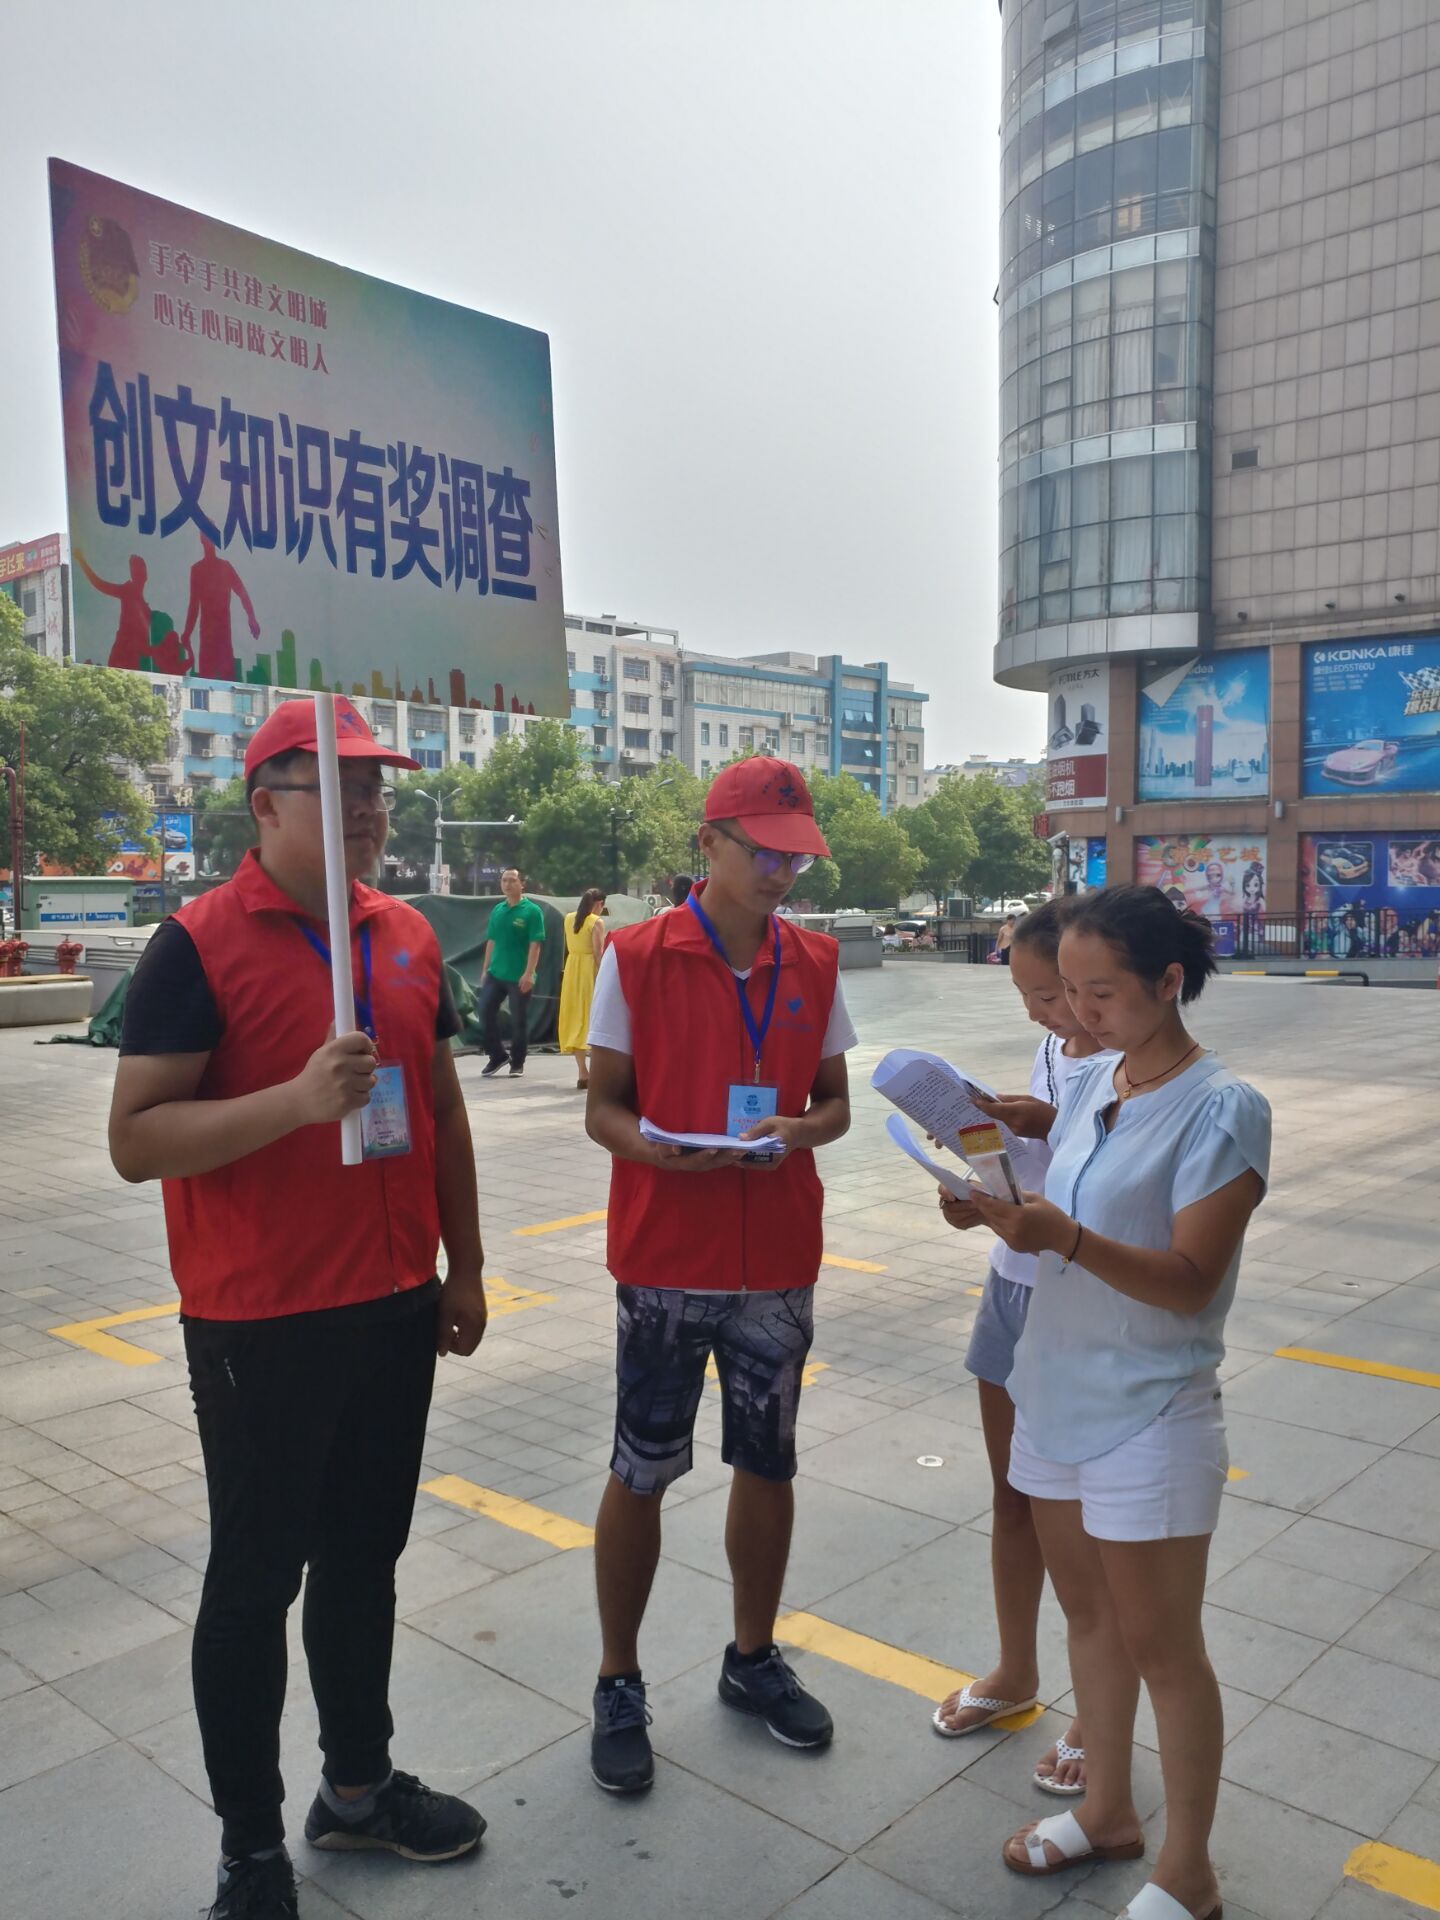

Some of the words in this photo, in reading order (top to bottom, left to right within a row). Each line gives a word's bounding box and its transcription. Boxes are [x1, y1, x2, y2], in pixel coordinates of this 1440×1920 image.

[149, 240, 328, 331] 手牵手共建文明城
[152, 291, 331, 374] 心连心同做文明人
[88, 360, 538, 601] 创文知识有奖调查
[1327, 647, 1387, 663] KONKA
